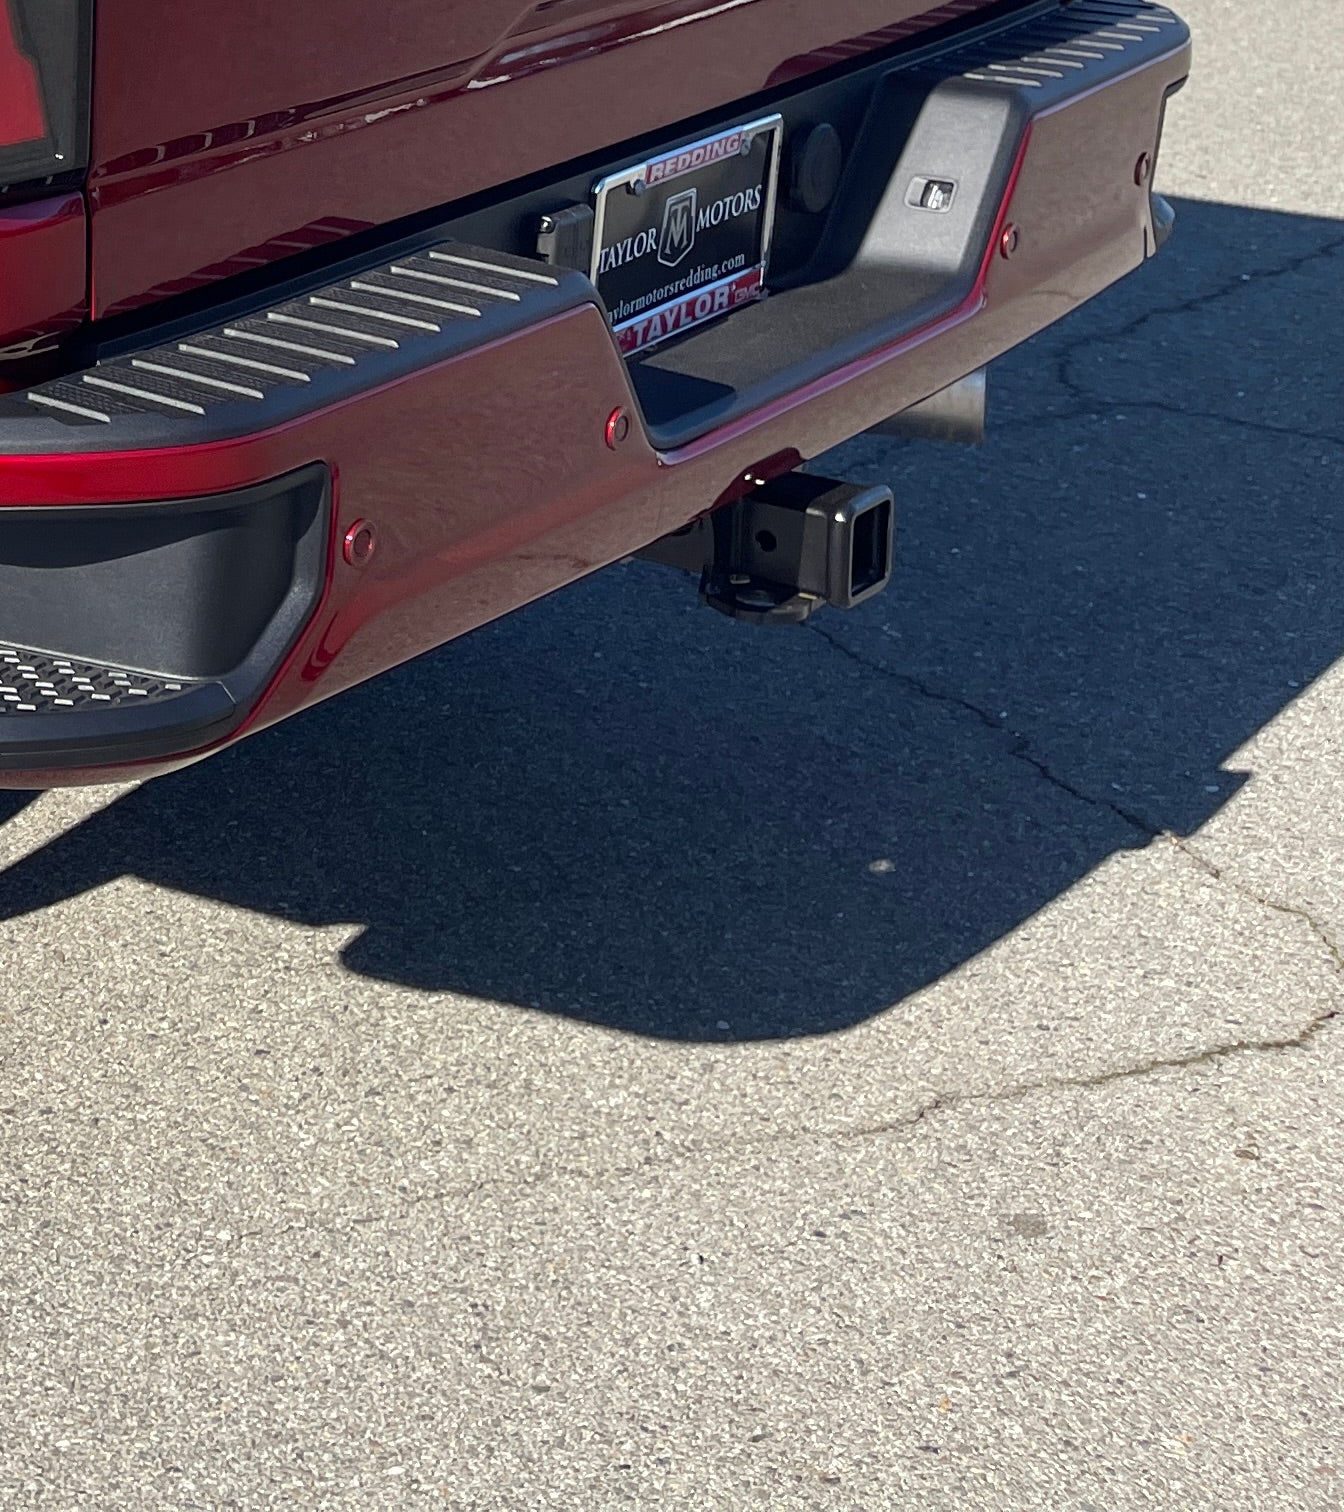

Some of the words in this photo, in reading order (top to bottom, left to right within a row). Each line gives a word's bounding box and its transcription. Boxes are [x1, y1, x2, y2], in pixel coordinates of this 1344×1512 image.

[650, 134, 740, 182] REDDING
[599, 227, 657, 274] TAYLOR
[696, 184, 762, 232] MOTORS
[608, 253, 745, 325] aylormotorsredding.com
[632, 287, 729, 347] TAYLOR
